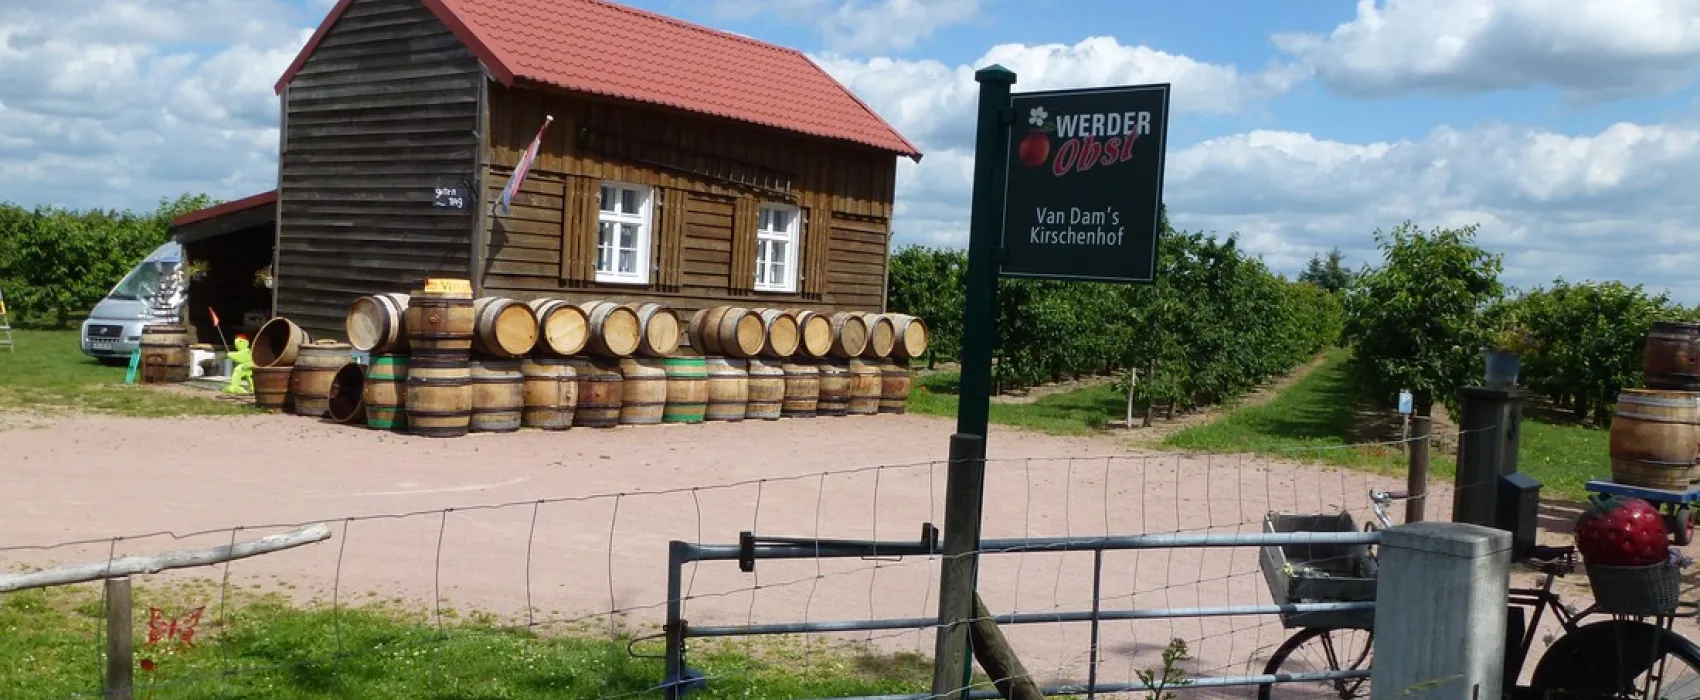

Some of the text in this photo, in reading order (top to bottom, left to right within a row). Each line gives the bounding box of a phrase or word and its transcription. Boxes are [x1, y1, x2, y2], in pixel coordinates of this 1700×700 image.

[1056, 111, 1151, 139] WERDER
[1053, 126, 1139, 176] Obst
[1036, 206, 1064, 225] Van
[1030, 226, 1124, 246] Kirschenhof
